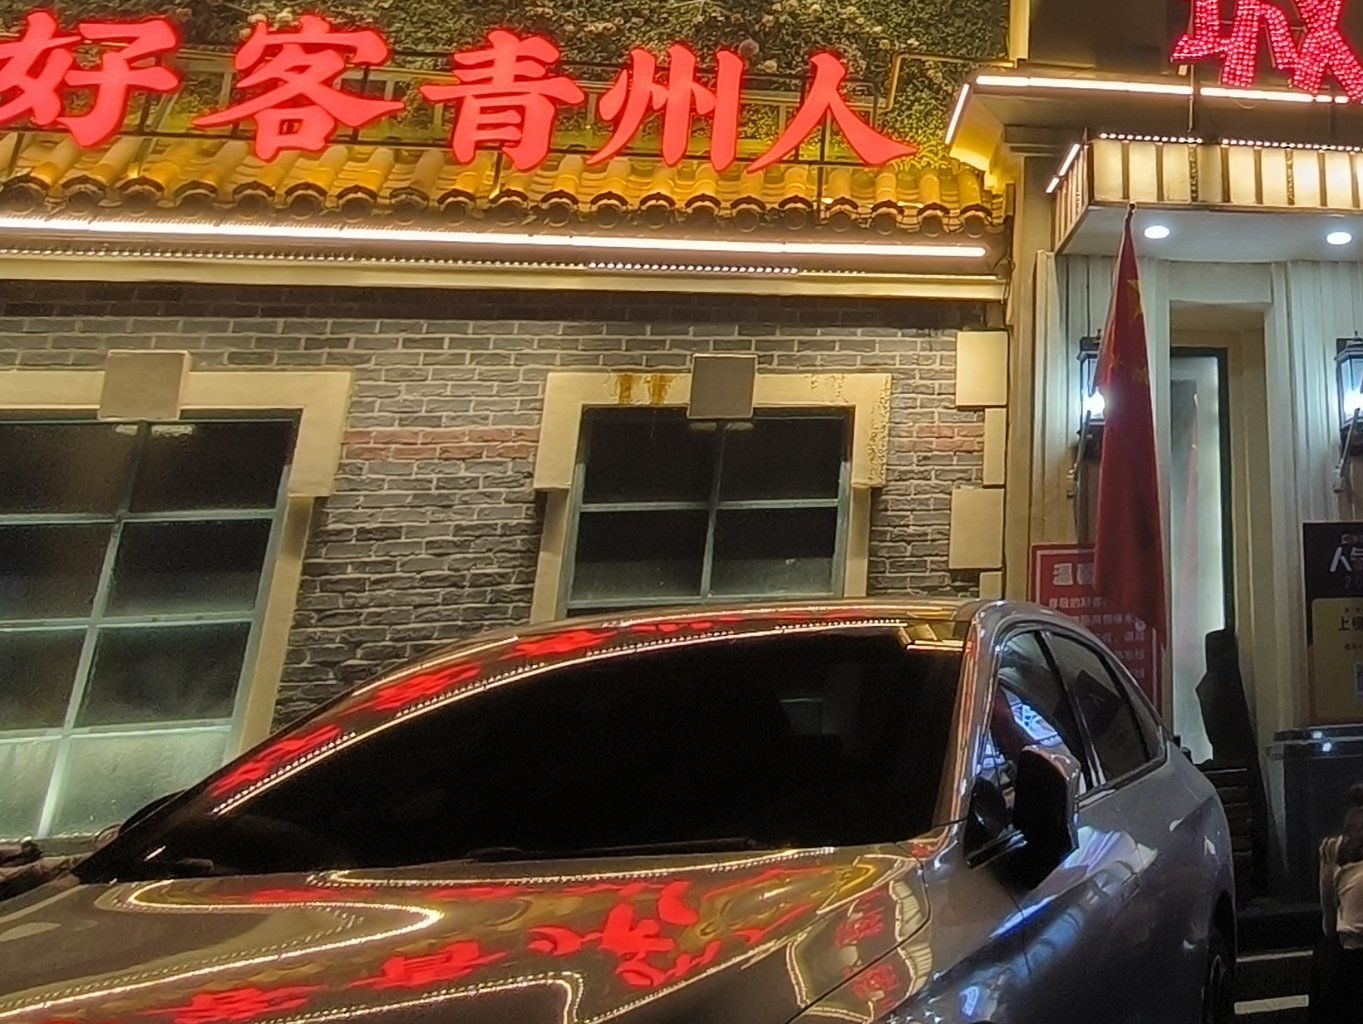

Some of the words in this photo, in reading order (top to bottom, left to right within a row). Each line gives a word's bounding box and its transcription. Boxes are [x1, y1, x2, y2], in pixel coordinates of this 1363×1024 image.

[0, 9, 920, 174] 好客青州人
